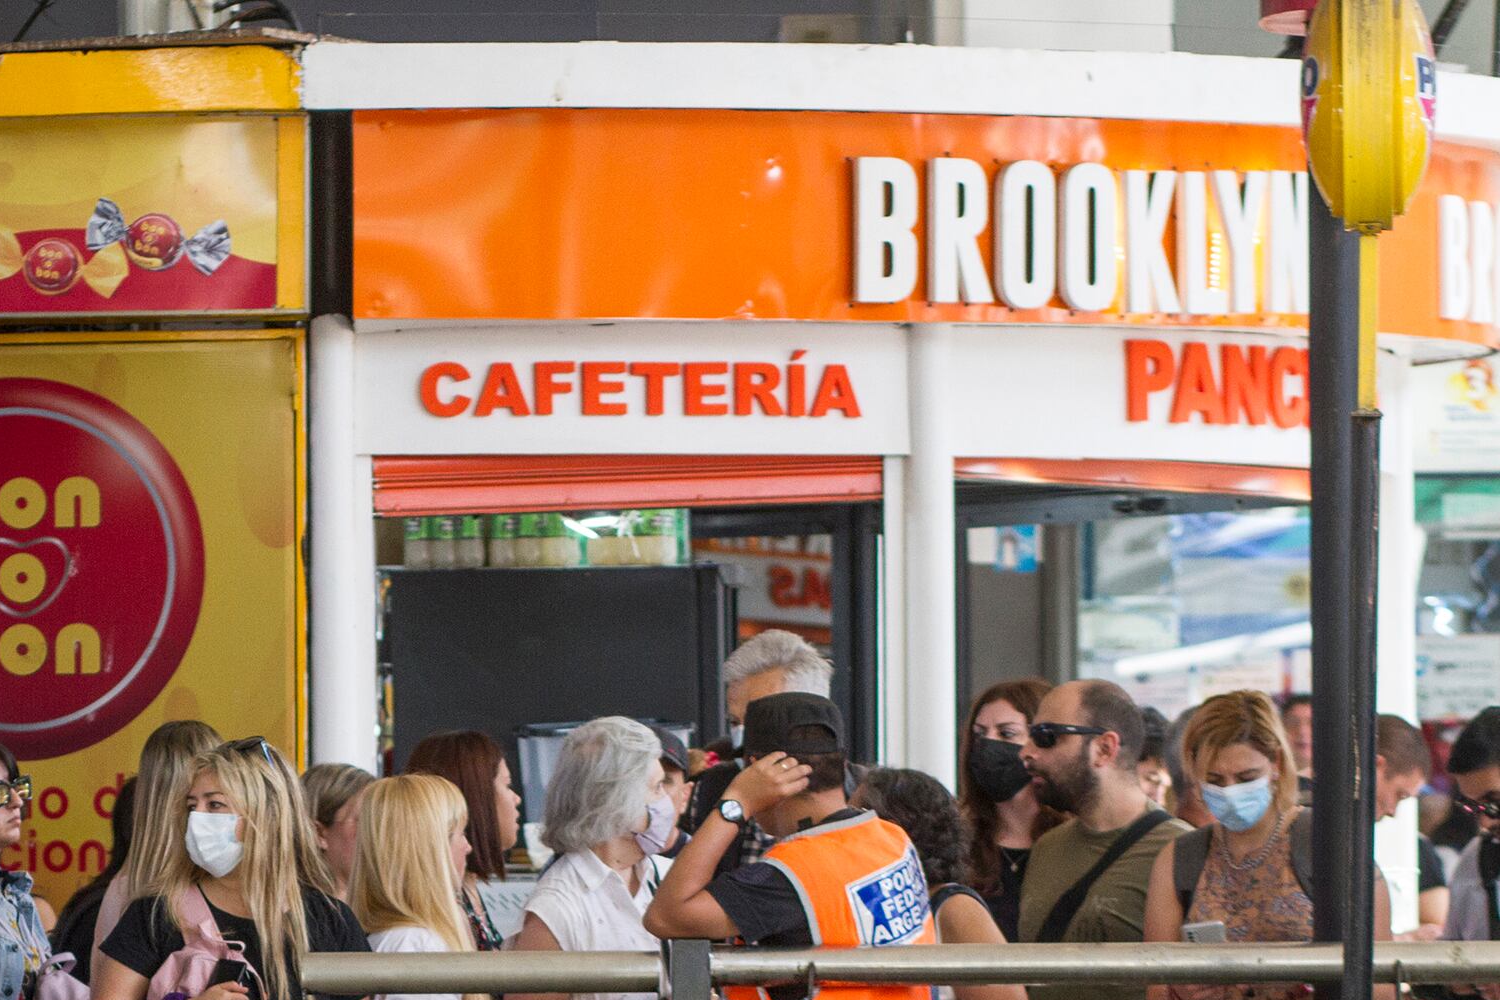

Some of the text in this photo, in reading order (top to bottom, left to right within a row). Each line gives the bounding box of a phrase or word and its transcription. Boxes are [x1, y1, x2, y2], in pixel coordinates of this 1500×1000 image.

[852, 156, 1310, 313] BROOKLYN
[1438, 194, 1500, 326] BR
[418, 349, 861, 418] CAFETERÍA
[1124, 338, 1311, 430] PANC
